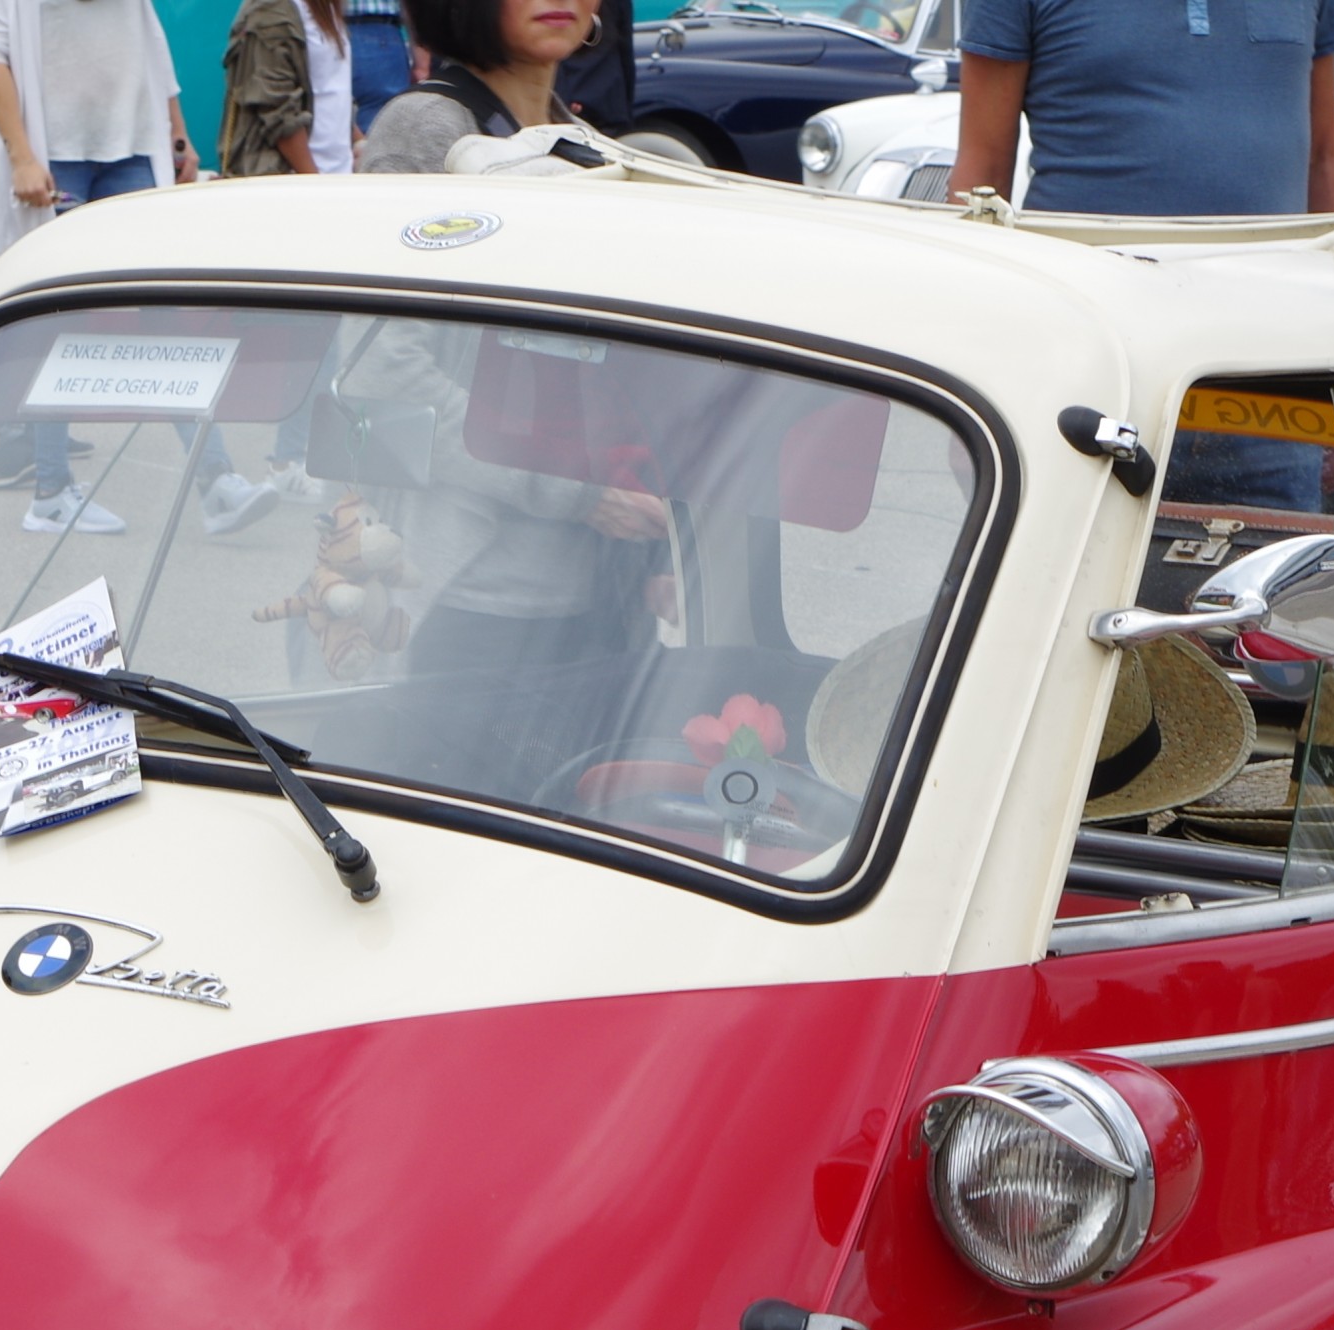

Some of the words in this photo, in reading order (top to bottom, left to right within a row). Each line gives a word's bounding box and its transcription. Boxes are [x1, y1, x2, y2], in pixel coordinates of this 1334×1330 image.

[60, 343, 109, 361] ENKEL
[111, 345, 226, 362] BEWONDEREN
[54, 377, 90, 393] MET
[91, 378, 116, 394] DE
[115, 379, 163, 395] OGEN
[163, 381, 199, 397] AUB
[61, 711, 123, 739] August
[58, 732, 131, 762] Thalfang
